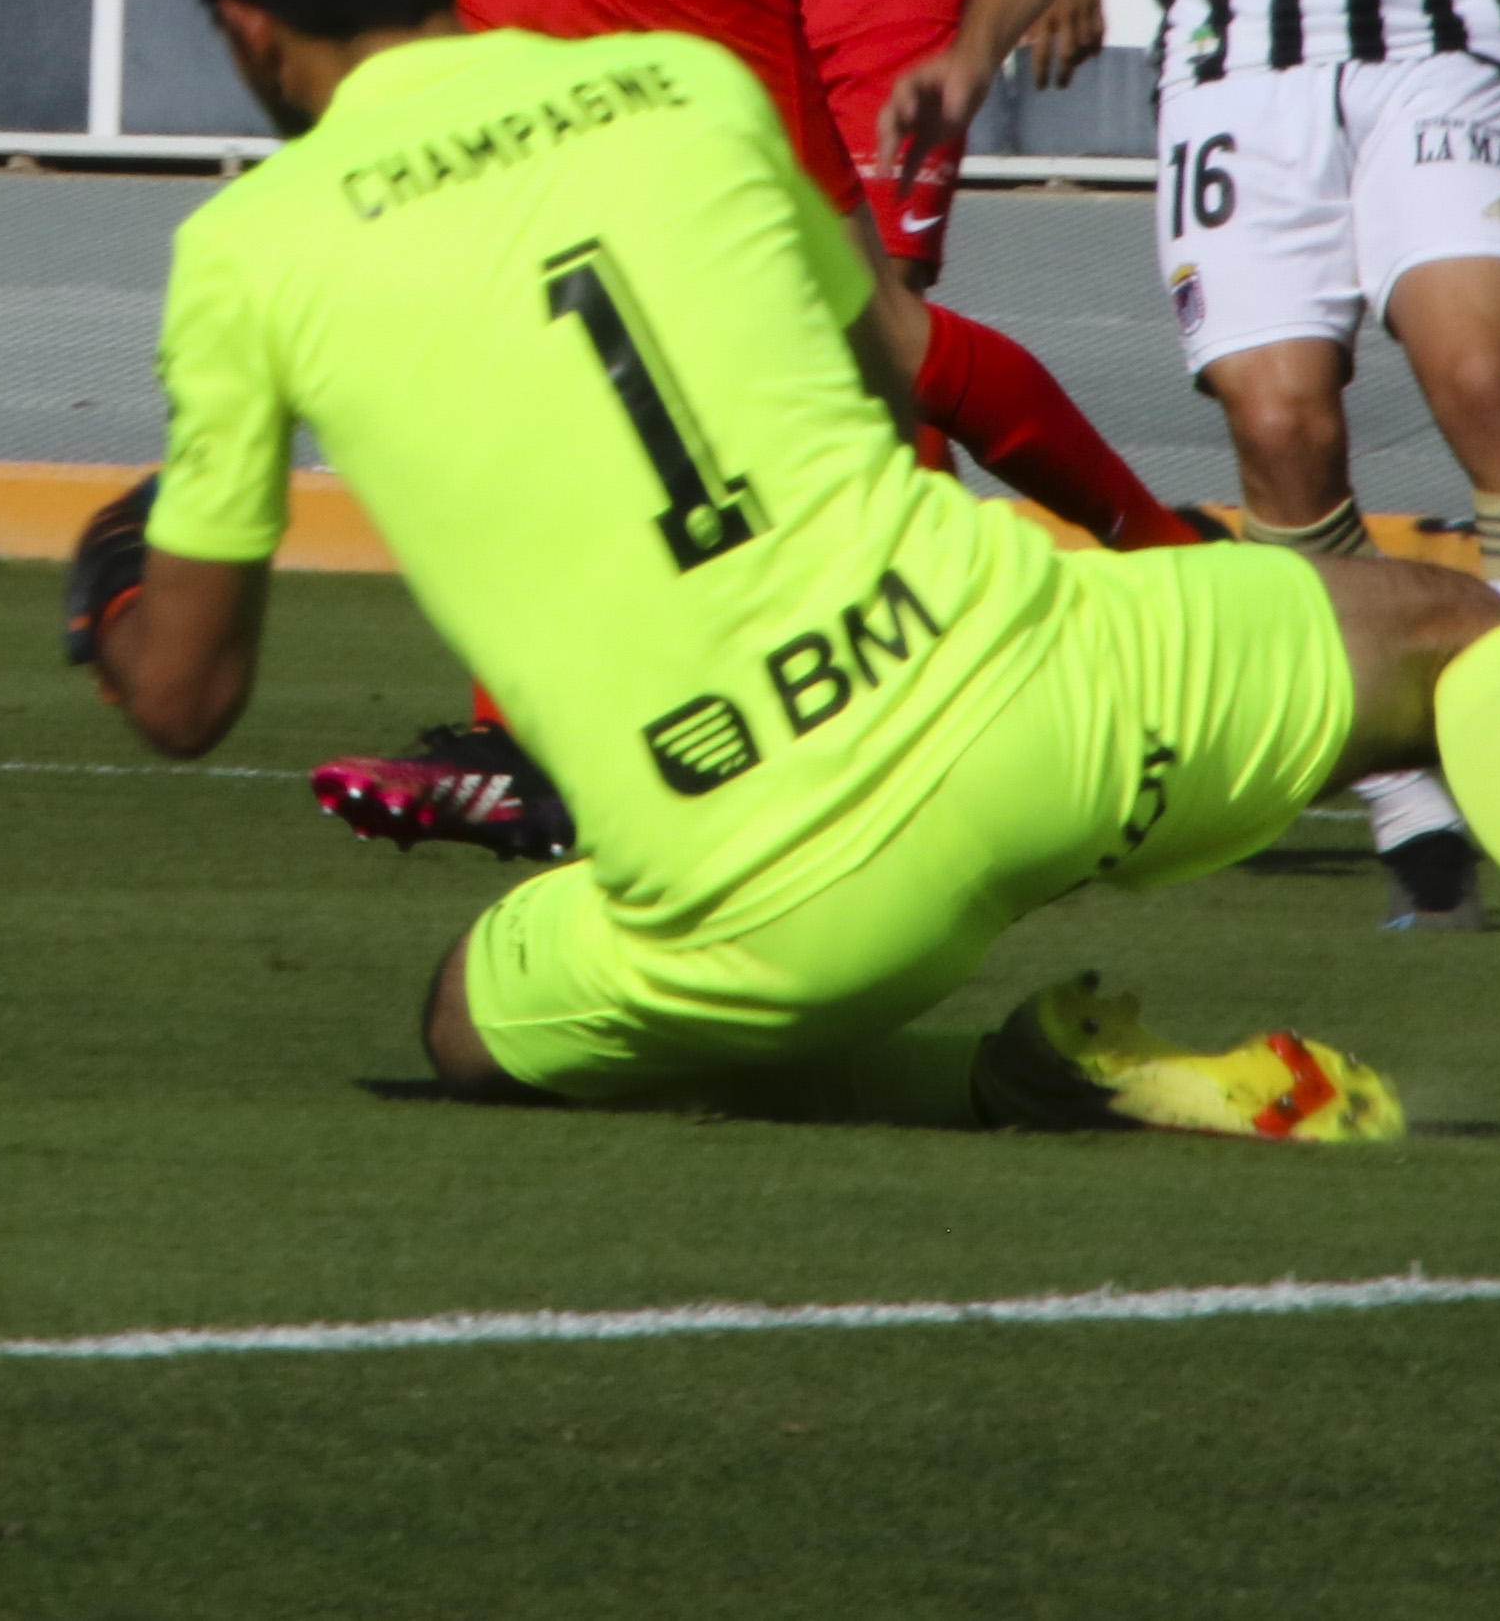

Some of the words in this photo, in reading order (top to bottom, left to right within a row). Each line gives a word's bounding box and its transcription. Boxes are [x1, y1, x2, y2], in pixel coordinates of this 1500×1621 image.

[341, 63, 690, 223] CHAMPAGNE
[1169, 132, 1238, 240] 16
[1415, 130, 1455, 165] LA
[542, 235, 776, 578] 1
[766, 568, 943, 740] BM
